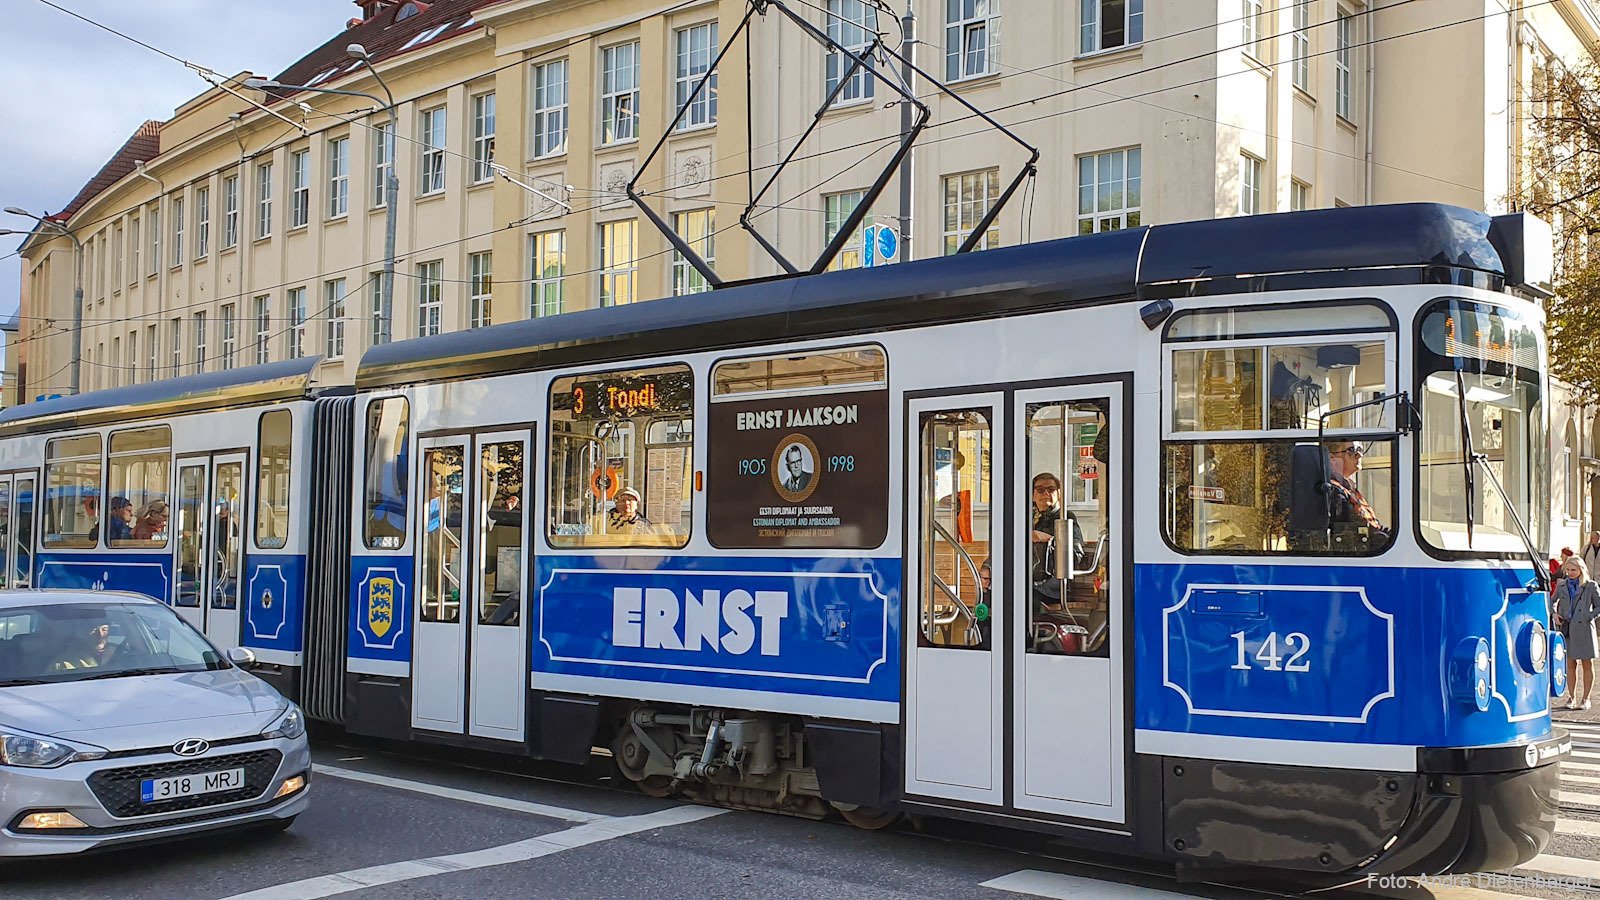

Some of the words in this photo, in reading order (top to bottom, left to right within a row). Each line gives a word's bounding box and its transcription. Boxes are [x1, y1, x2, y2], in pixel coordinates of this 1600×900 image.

[573, 387, 584, 414] 3
[607, 383, 655, 410] Tondi
[736, 409, 783, 431] ERNST
[786, 404, 858, 429] JAAKSON
[738, 458, 766, 475] 1905
[828, 455, 855, 473] 1998
[752, 518, 775, 527] ESTONIAN
[775, 517, 798, 526] DIPLOMAT
[798, 517, 808, 526] AND
[808, 517, 841, 526] AMBASSADOR
[759, 507, 772, 516] EESTI
[772, 506, 797, 516] DIPLOMAAT
[803, 506, 834, 515] SUURSAADIK
[612, 587, 789, 657] ERNST
[1230, 630, 1311, 673] 142
[160, 778, 191, 796] 318
[204, 770, 240, 791] MRJ
